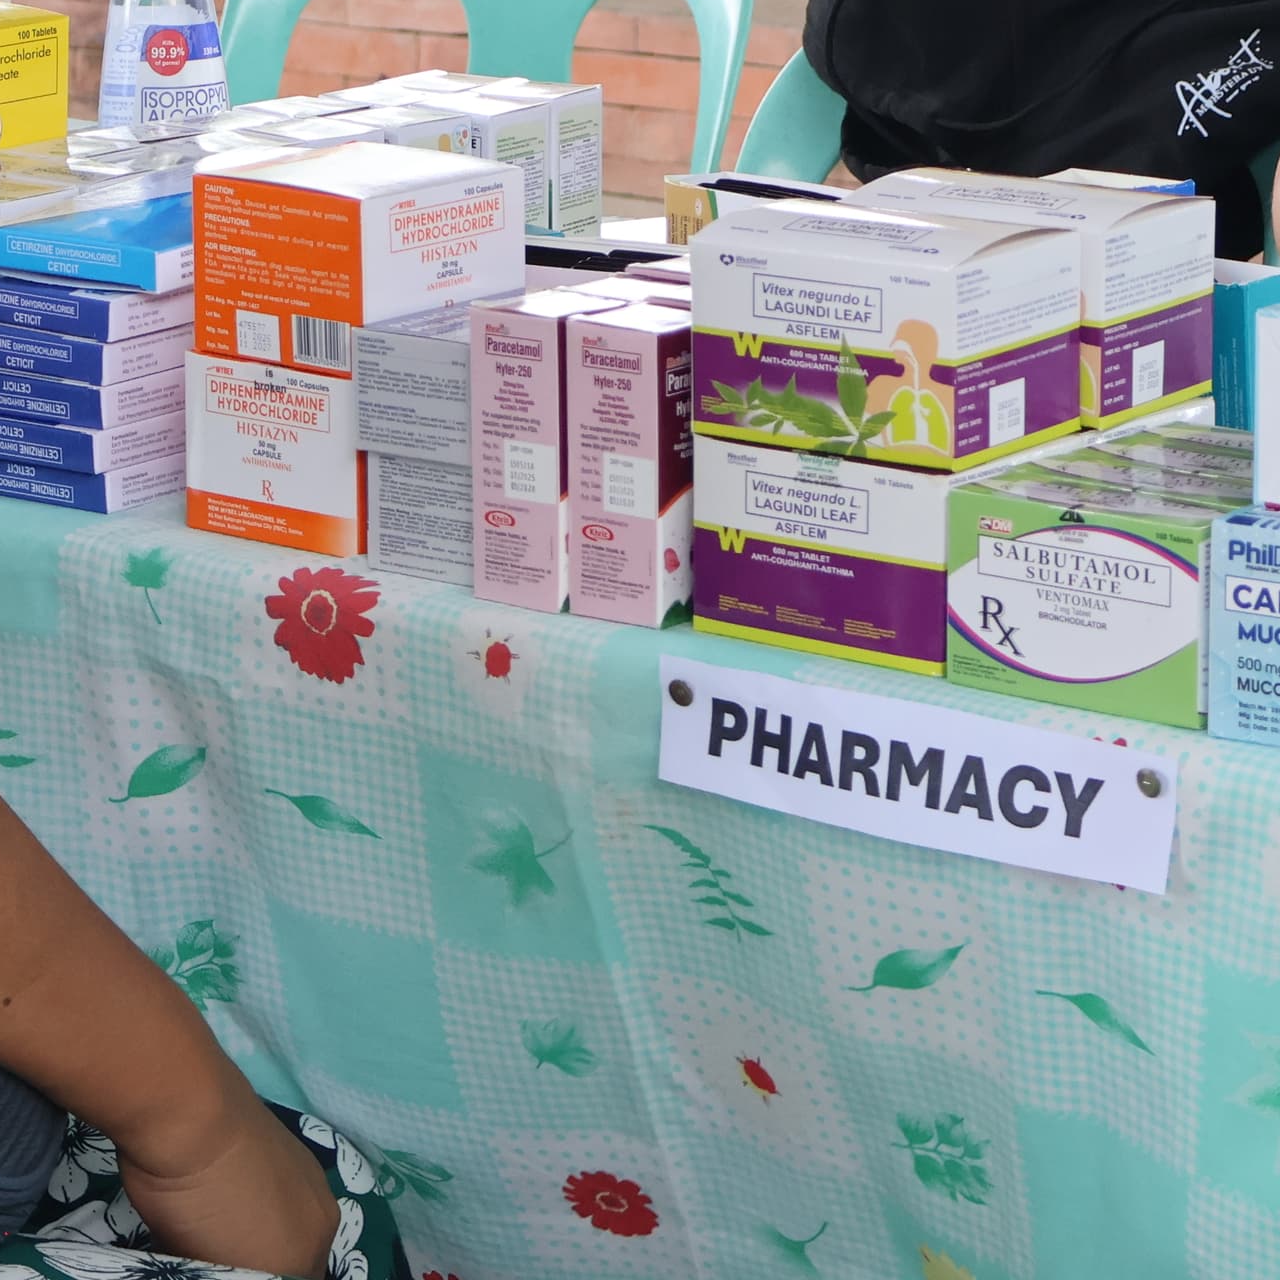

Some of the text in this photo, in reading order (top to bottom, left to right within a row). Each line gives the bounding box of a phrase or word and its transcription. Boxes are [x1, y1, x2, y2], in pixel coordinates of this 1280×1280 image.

[18, 26, 57, 40] 100 Tablets
[151, 47, 185, 59] 99.9%
[144, 87, 227, 108] ISOPROPYL
[476, 183, 503, 195] Capsules
[394, 198, 500, 231] DIPHENHYDRAMINE
[402, 215, 494, 245] HYDROCHLORIDE
[11, 239, 118, 263] CETIRIZINE DIHYDROCHLORIDE
[421, 240, 478, 263] HISTAZYN
[48, 261, 79, 273] CETICIT
[449, 261, 458, 269] mg
[437, 268, 463, 279] CAPSULE
[762, 282, 876, 307] Vitex negundo L.
[20, 298, 76, 315] DIHYDROCHLORIDE
[765, 300, 872, 323] LAGUNDI LEAF
[13, 312, 41, 326] CETICIT
[785, 323, 840, 340] ASFLEM
[13, 342, 69, 359] DIHYDROCHLORIDE
[487, 338, 541, 357] Paracetamol
[6, 356, 34, 369] CETICIT
[584, 350, 640, 370] Paracetamol
[819, 353, 850, 364] TABLET
[265, 368, 273, 377] is
[495, 362, 532, 378] Hyfer-250
[2, 380, 31, 394] CETICIT
[254, 381, 286, 393] broken
[287, 377, 329, 392] 100 Capsules
[594, 375, 632, 391] Hyfer-250
[210, 380, 325, 412] DIPHENHYDRAMINE
[26, 401, 66, 415] CETIRIZINE
[218, 396, 317, 425] HYDROCHLORIDE
[236, 421, 298, 443] HISTAZYN
[19, 444, 59, 460] CETIRIZINE
[253, 448, 281, 460] CAPSULE
[267, 442, 276, 451] mg
[6, 463, 35, 476] CETICIT
[31, 484, 70, 499] CETIRIZINE
[888, 479, 914, 490] Tablets
[752, 480, 861, 508] Vitex negundo L.
[755, 497, 857, 524] LAGUNDI LEAF
[775, 522, 827, 539] ASFLEM
[787, 549, 831, 563] mg TABLET
[993, 542, 1157, 585] SALBUTAMOL
[751, 553, 855, 578] ANTI-COUGH/ANTI-ASTHMA
[1026, 566, 1122, 594] SULFATE
[1036, 588, 1110, 611] VENTOMAX
[1038, 611, 1107, 630] BRONCHODILATOR
[1237, 656, 1262, 672] 500
[708, 697, 1104, 839] PHARMACY
